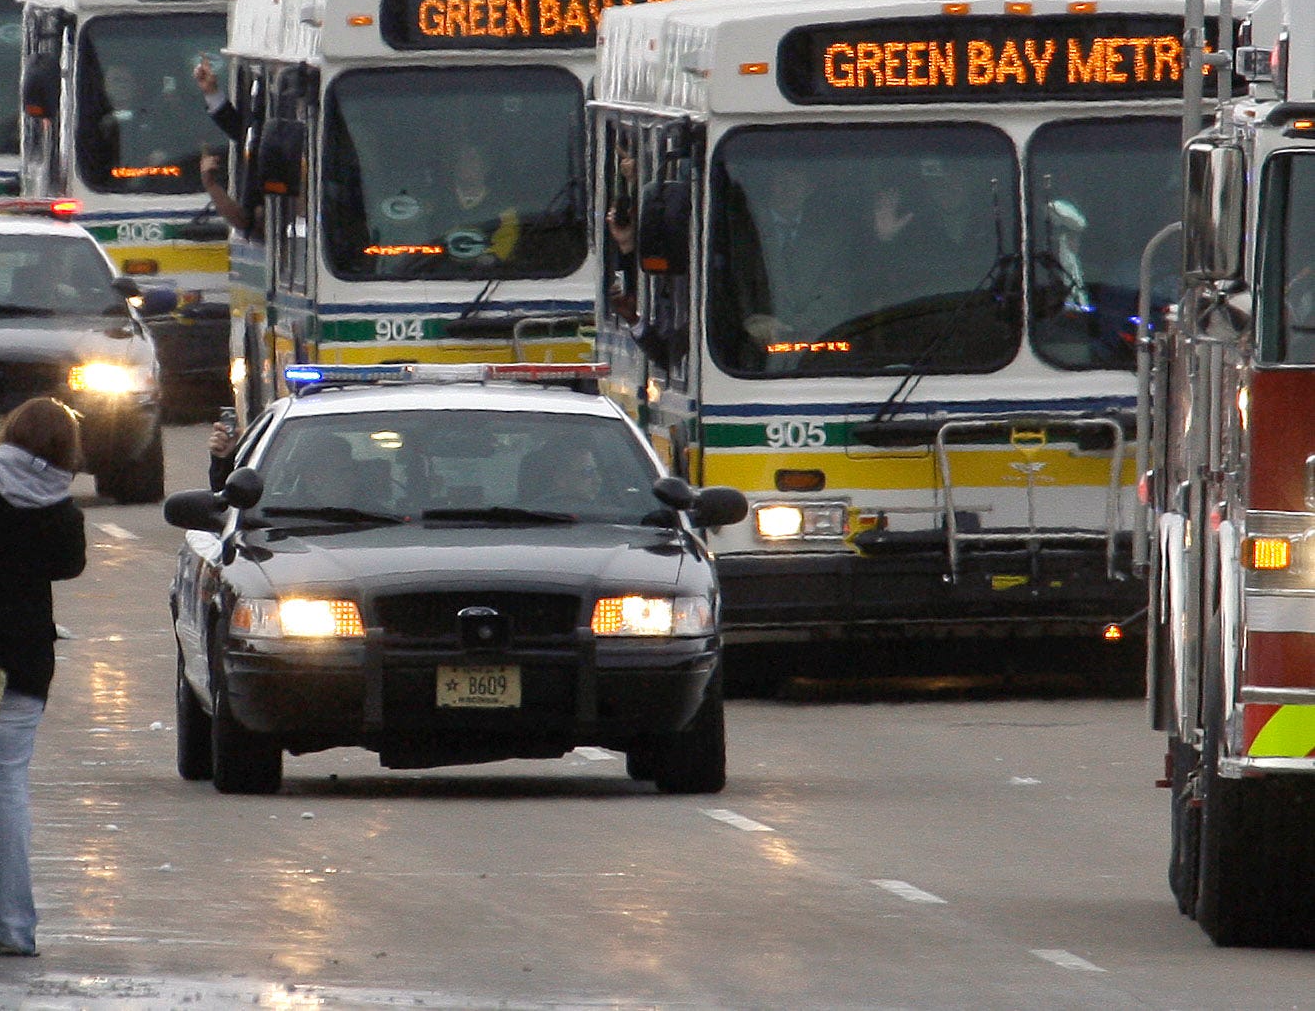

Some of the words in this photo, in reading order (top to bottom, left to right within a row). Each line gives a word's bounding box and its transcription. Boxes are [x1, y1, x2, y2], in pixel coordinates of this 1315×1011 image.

[823, 41, 955, 88] GREEN
[967, 38, 1056, 86] BAY
[1067, 35, 1210, 84] METR
[117, 222, 163, 241] 906
[375, 319, 424, 341] 904
[766, 421, 826, 447] 905
